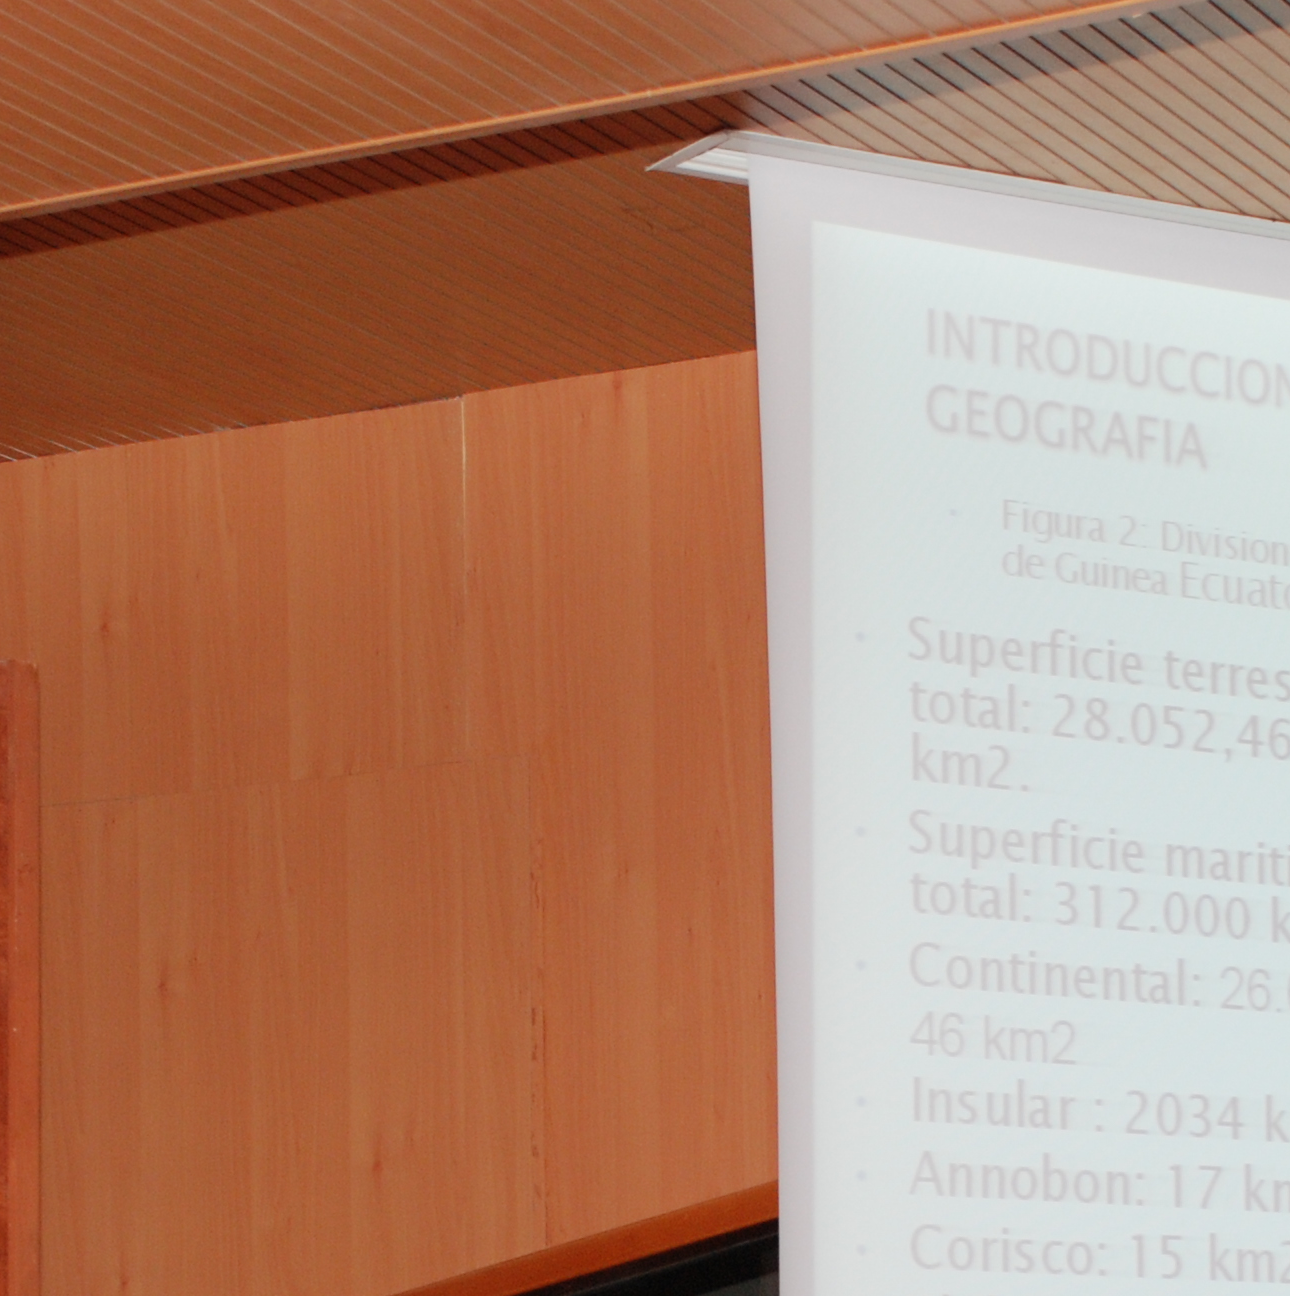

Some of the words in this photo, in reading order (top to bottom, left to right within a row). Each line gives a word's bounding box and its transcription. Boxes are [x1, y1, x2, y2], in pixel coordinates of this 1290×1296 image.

[925, 384, 1208, 470] GEOGRAFIA
[1001, 499, 1106, 544] Figura
[1161, 520, 1290, 567] Division
[1001, 545, 1046, 579] de
[1054, 552, 1169, 597] Guinea
[908, 615, 1145, 686] Superficie
[909, 681, 1031, 733] total:
[908, 809, 1146, 874] Superficie
[910, 872, 1033, 922] total:
[1055, 881, 1250, 940] 312.000
[908, 942, 1202, 1007] Continental:
[910, 1011, 965, 1057] 46
[983, 1015, 1077, 1066] km2
[1125, 1089, 1246, 1140] 2034
[909, 1150, 1146, 1206] Annobon:
[1170, 1163, 1224, 1210] 17
[910, 1223, 1107, 1278] Corisco:
[1132, 1234, 1184, 1279] 15
